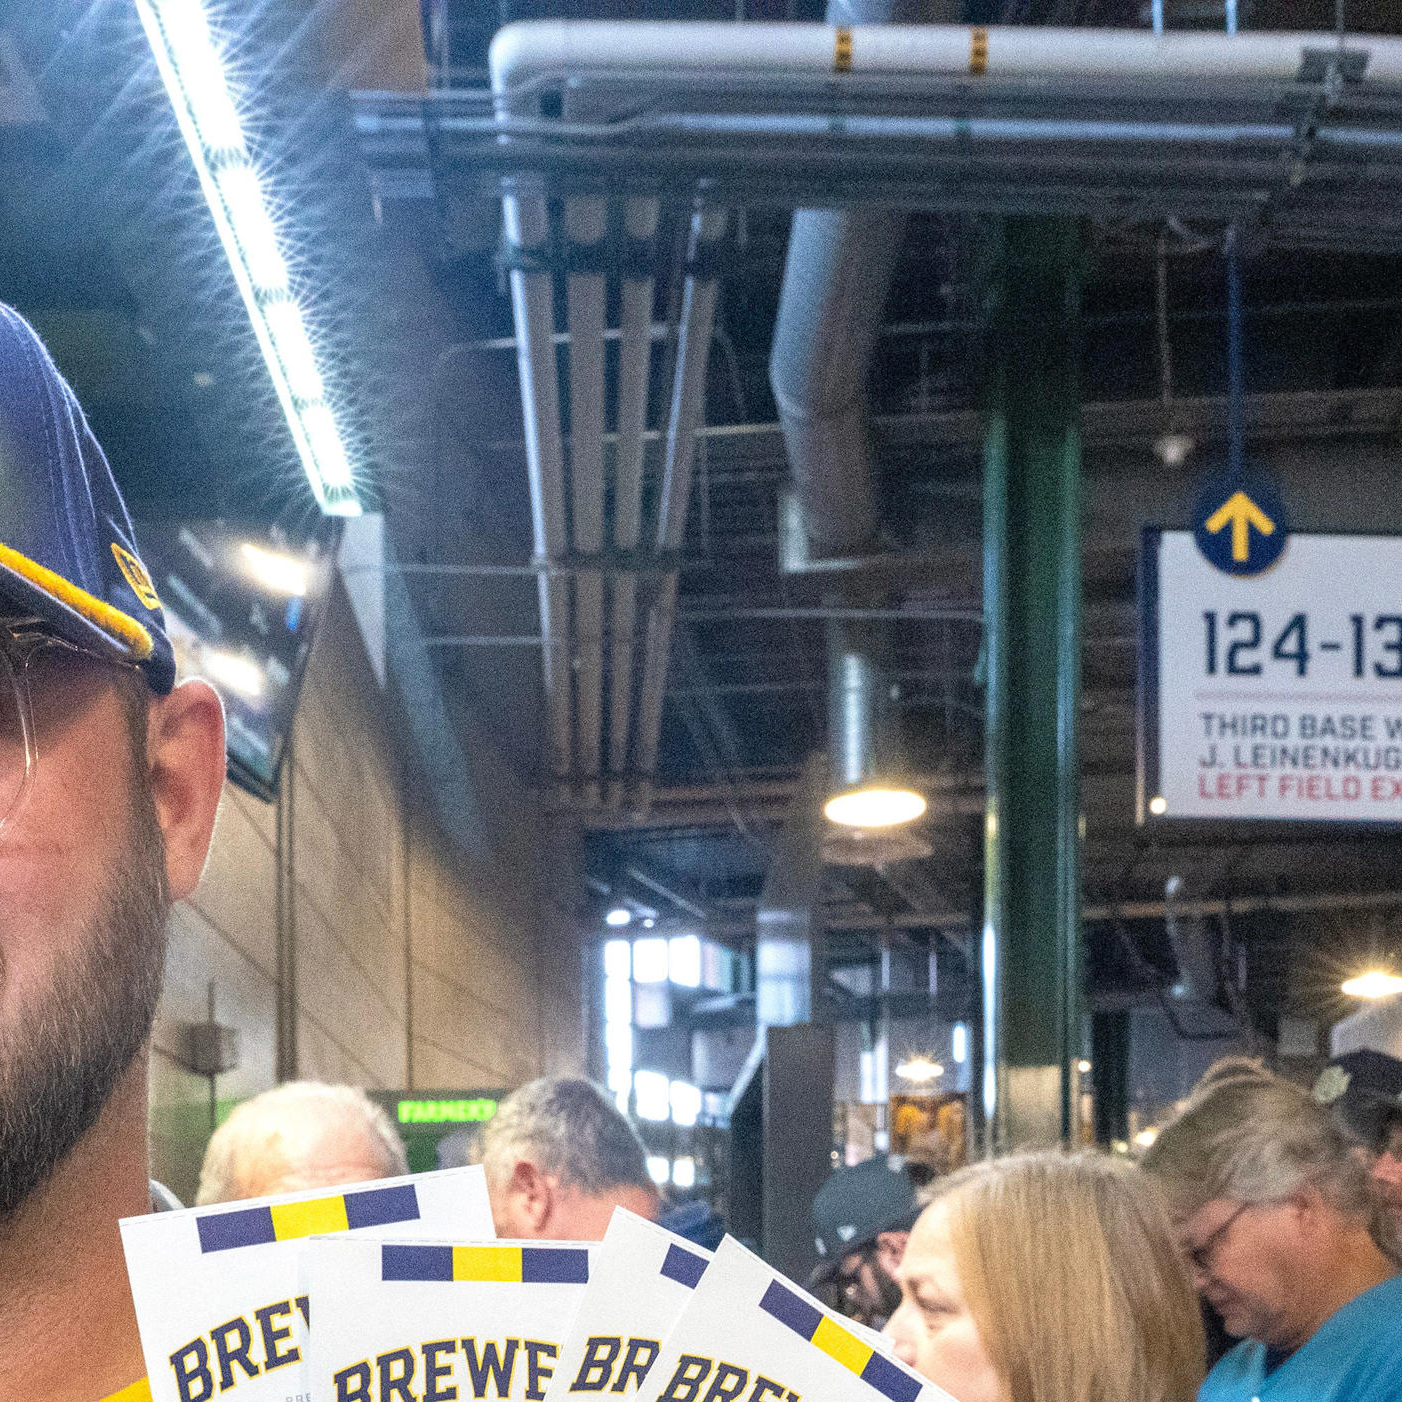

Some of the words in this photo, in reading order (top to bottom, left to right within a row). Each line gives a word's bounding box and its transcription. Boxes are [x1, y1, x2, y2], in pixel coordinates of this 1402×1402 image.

[1201, 713, 1290, 740] THIRD
[1299, 715, 1375, 742] BASE
[1199, 745, 1226, 769] J.
[1199, 774, 1268, 800] LEFT
[1278, 776, 1361, 801] FIELD
